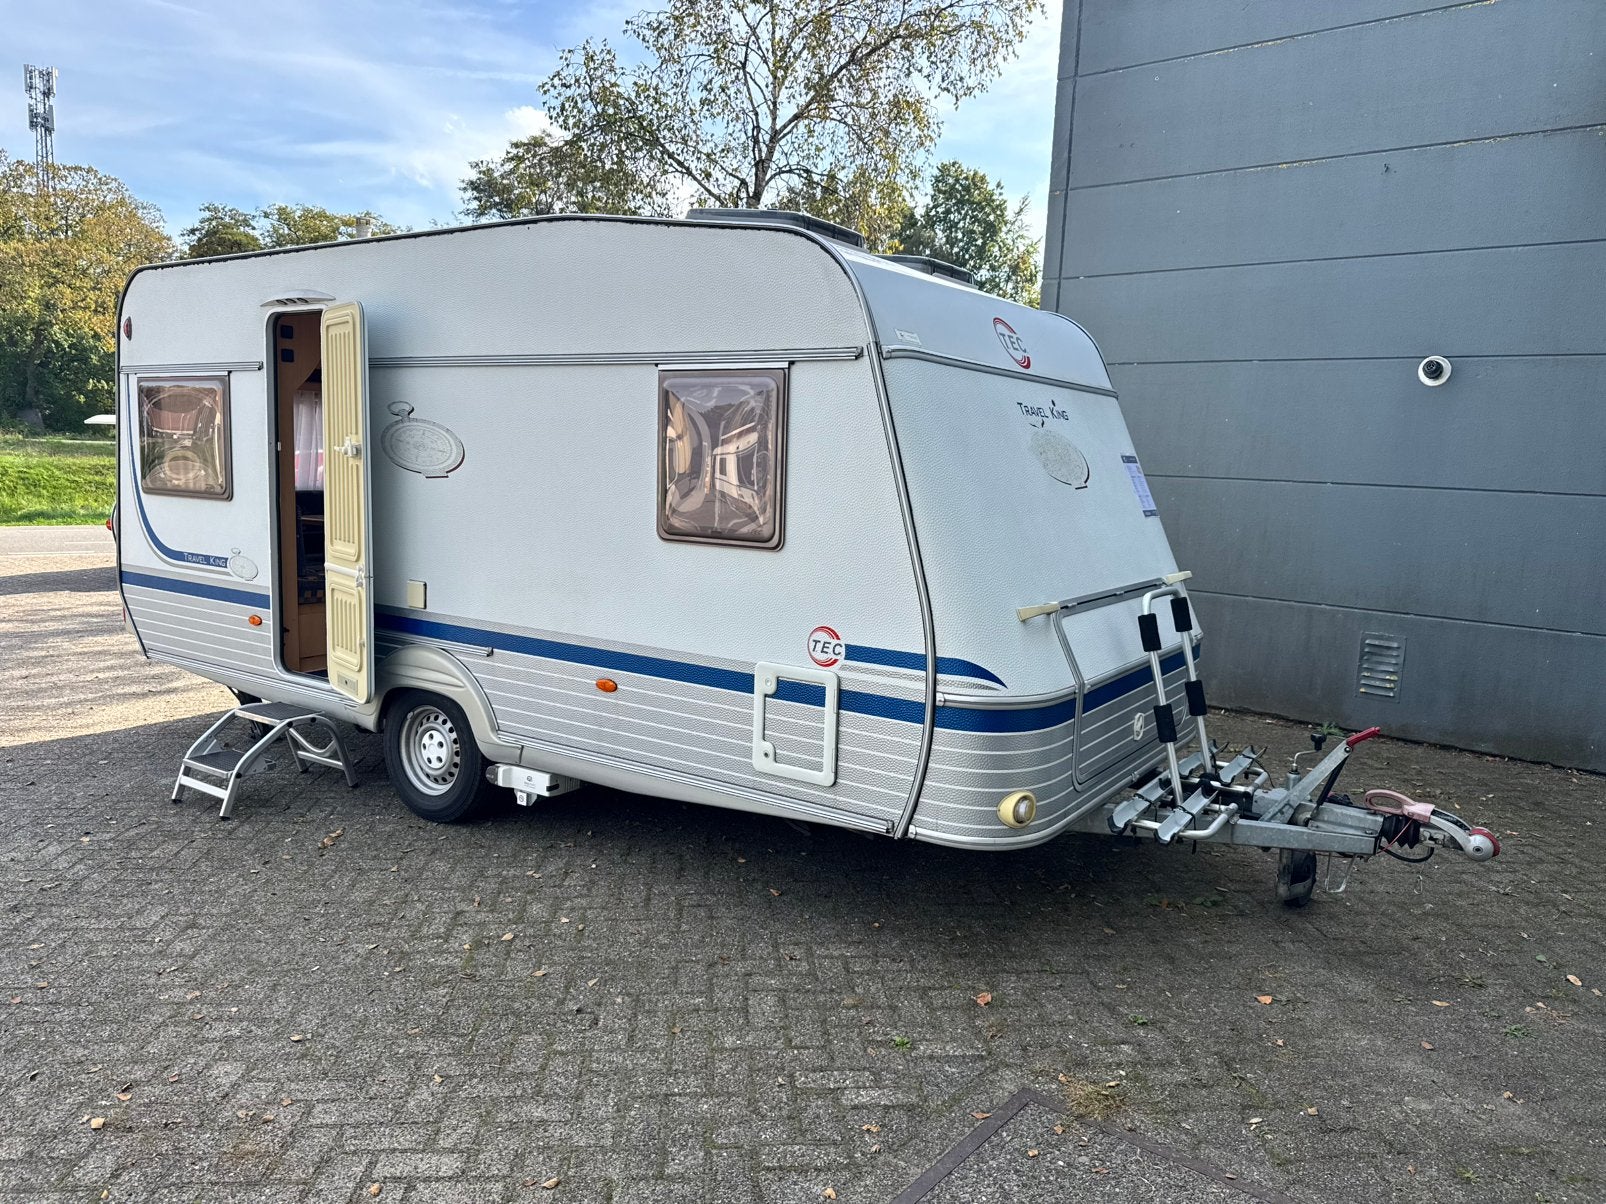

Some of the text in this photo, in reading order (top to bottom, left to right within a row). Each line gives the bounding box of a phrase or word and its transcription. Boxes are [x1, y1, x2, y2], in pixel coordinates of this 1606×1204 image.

[999, 332, 1027, 354] TEC
[1017, 402, 1069, 421] TRAVEL KING
[183, 552, 226, 567] TRAVEL KING
[812, 639, 843, 656] TEC
